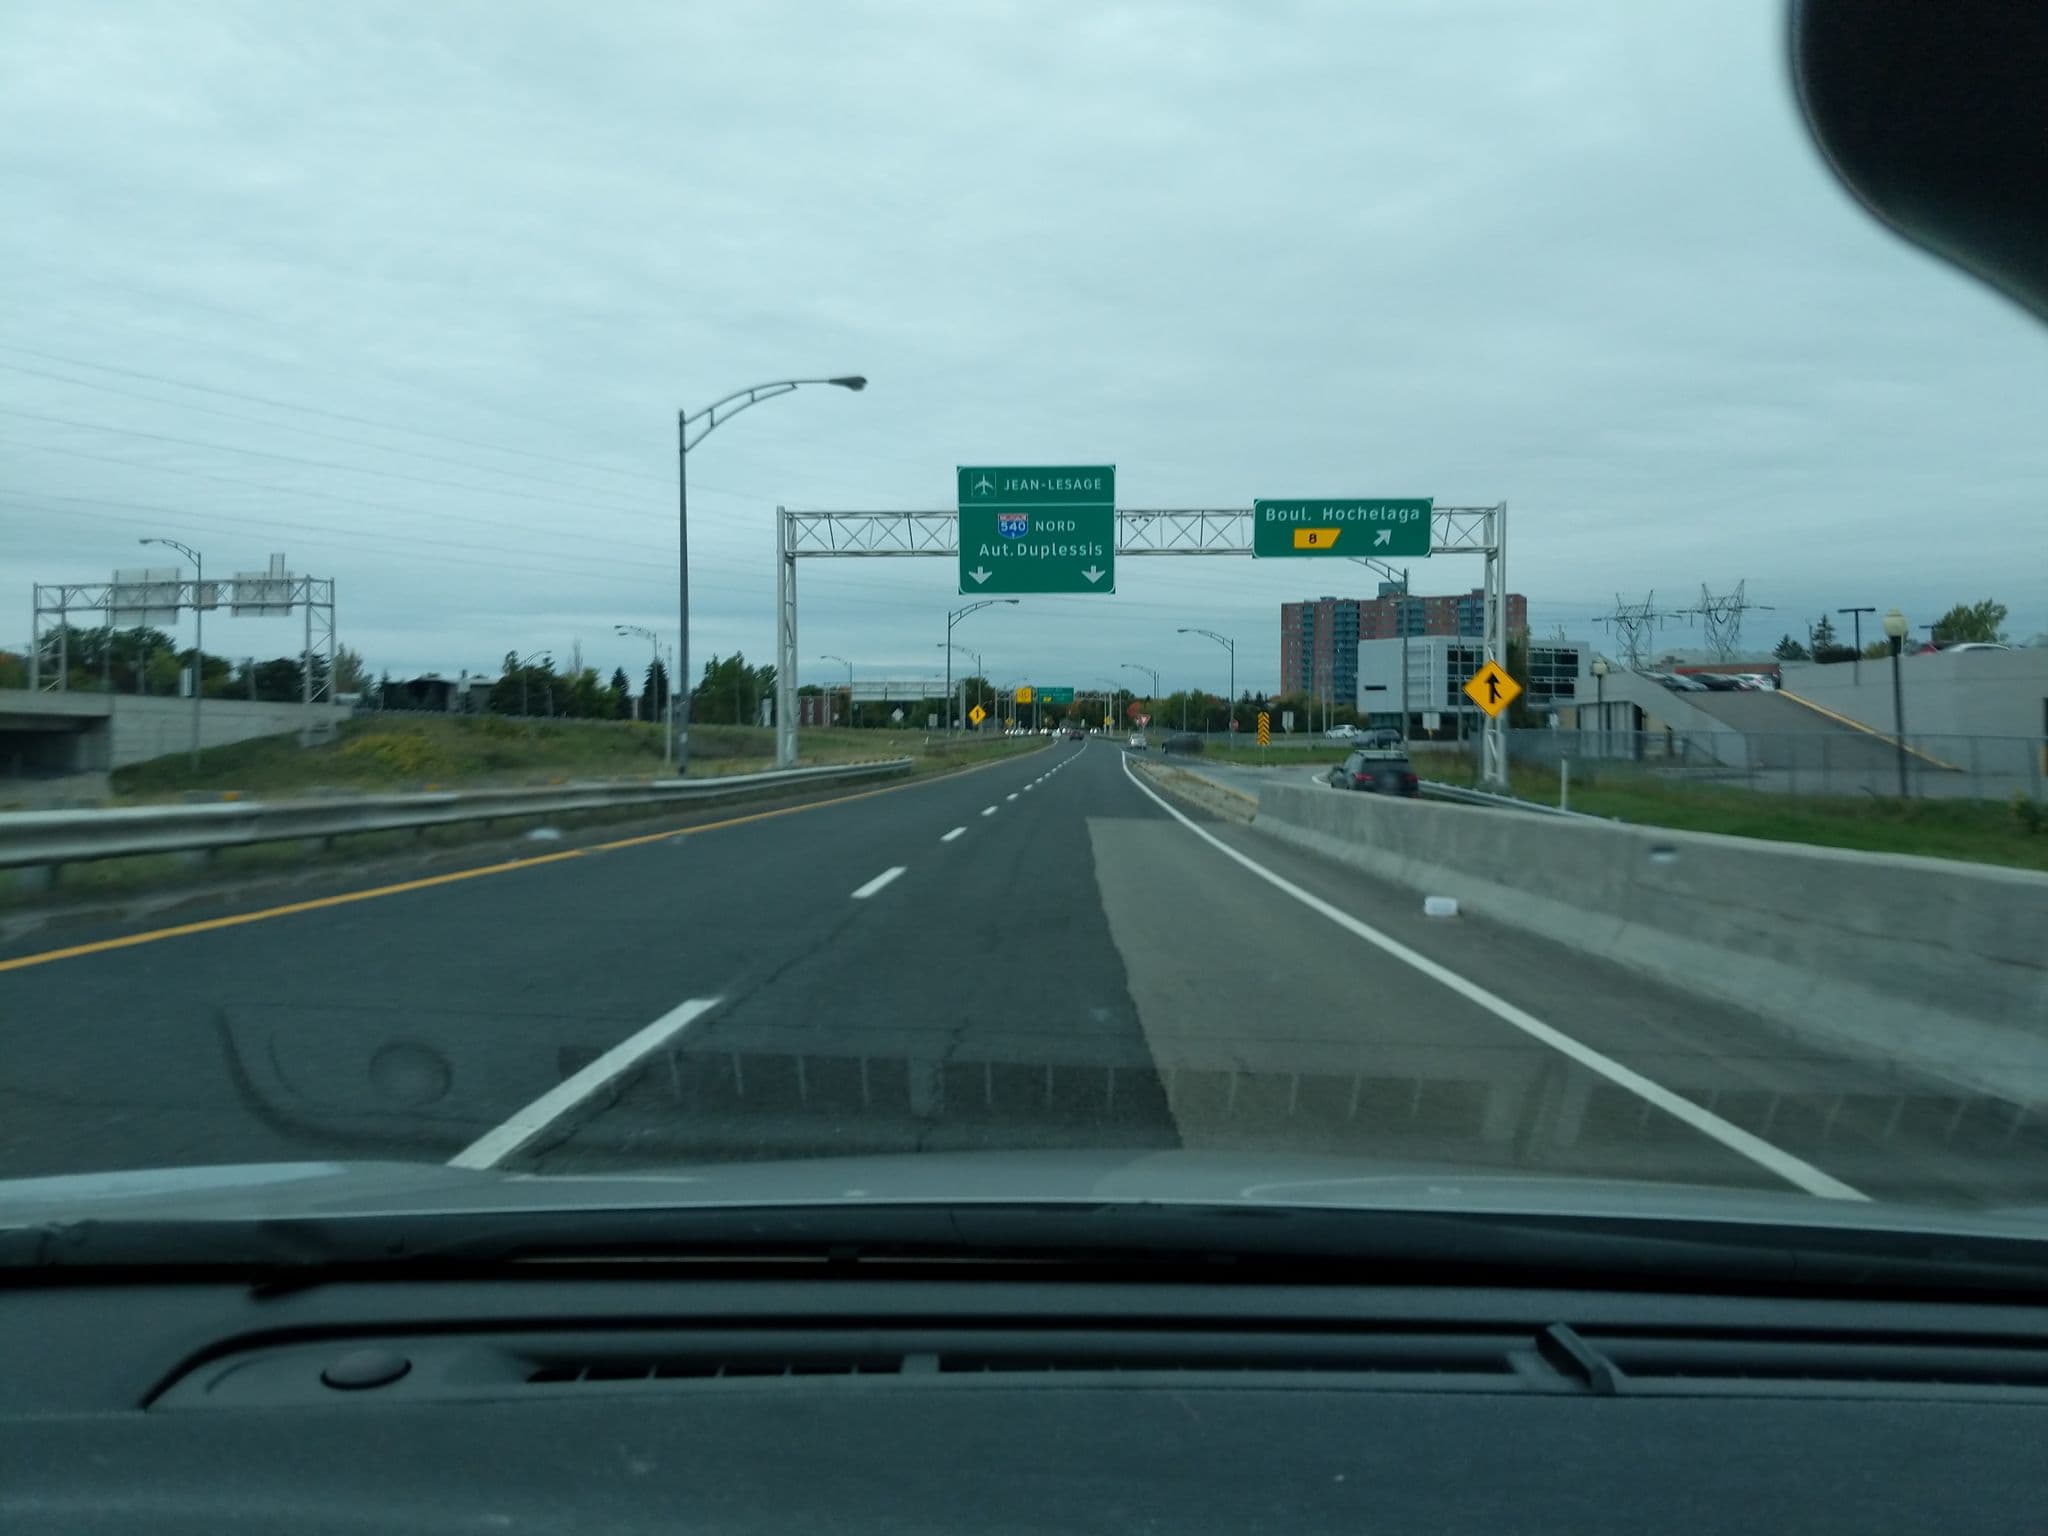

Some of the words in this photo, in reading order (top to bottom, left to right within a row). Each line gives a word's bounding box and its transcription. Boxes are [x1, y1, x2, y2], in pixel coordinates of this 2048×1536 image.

[1003, 478, 1102, 491] JEAN-LESAGE
[1265, 507, 1312, 522] Boul.
[1322, 505, 1420, 524] Hochelaga
[1000, 520, 1026, 532] 540
[1035, 520, 1076, 532] NORD
[1308, 533, 1318, 545] 8
